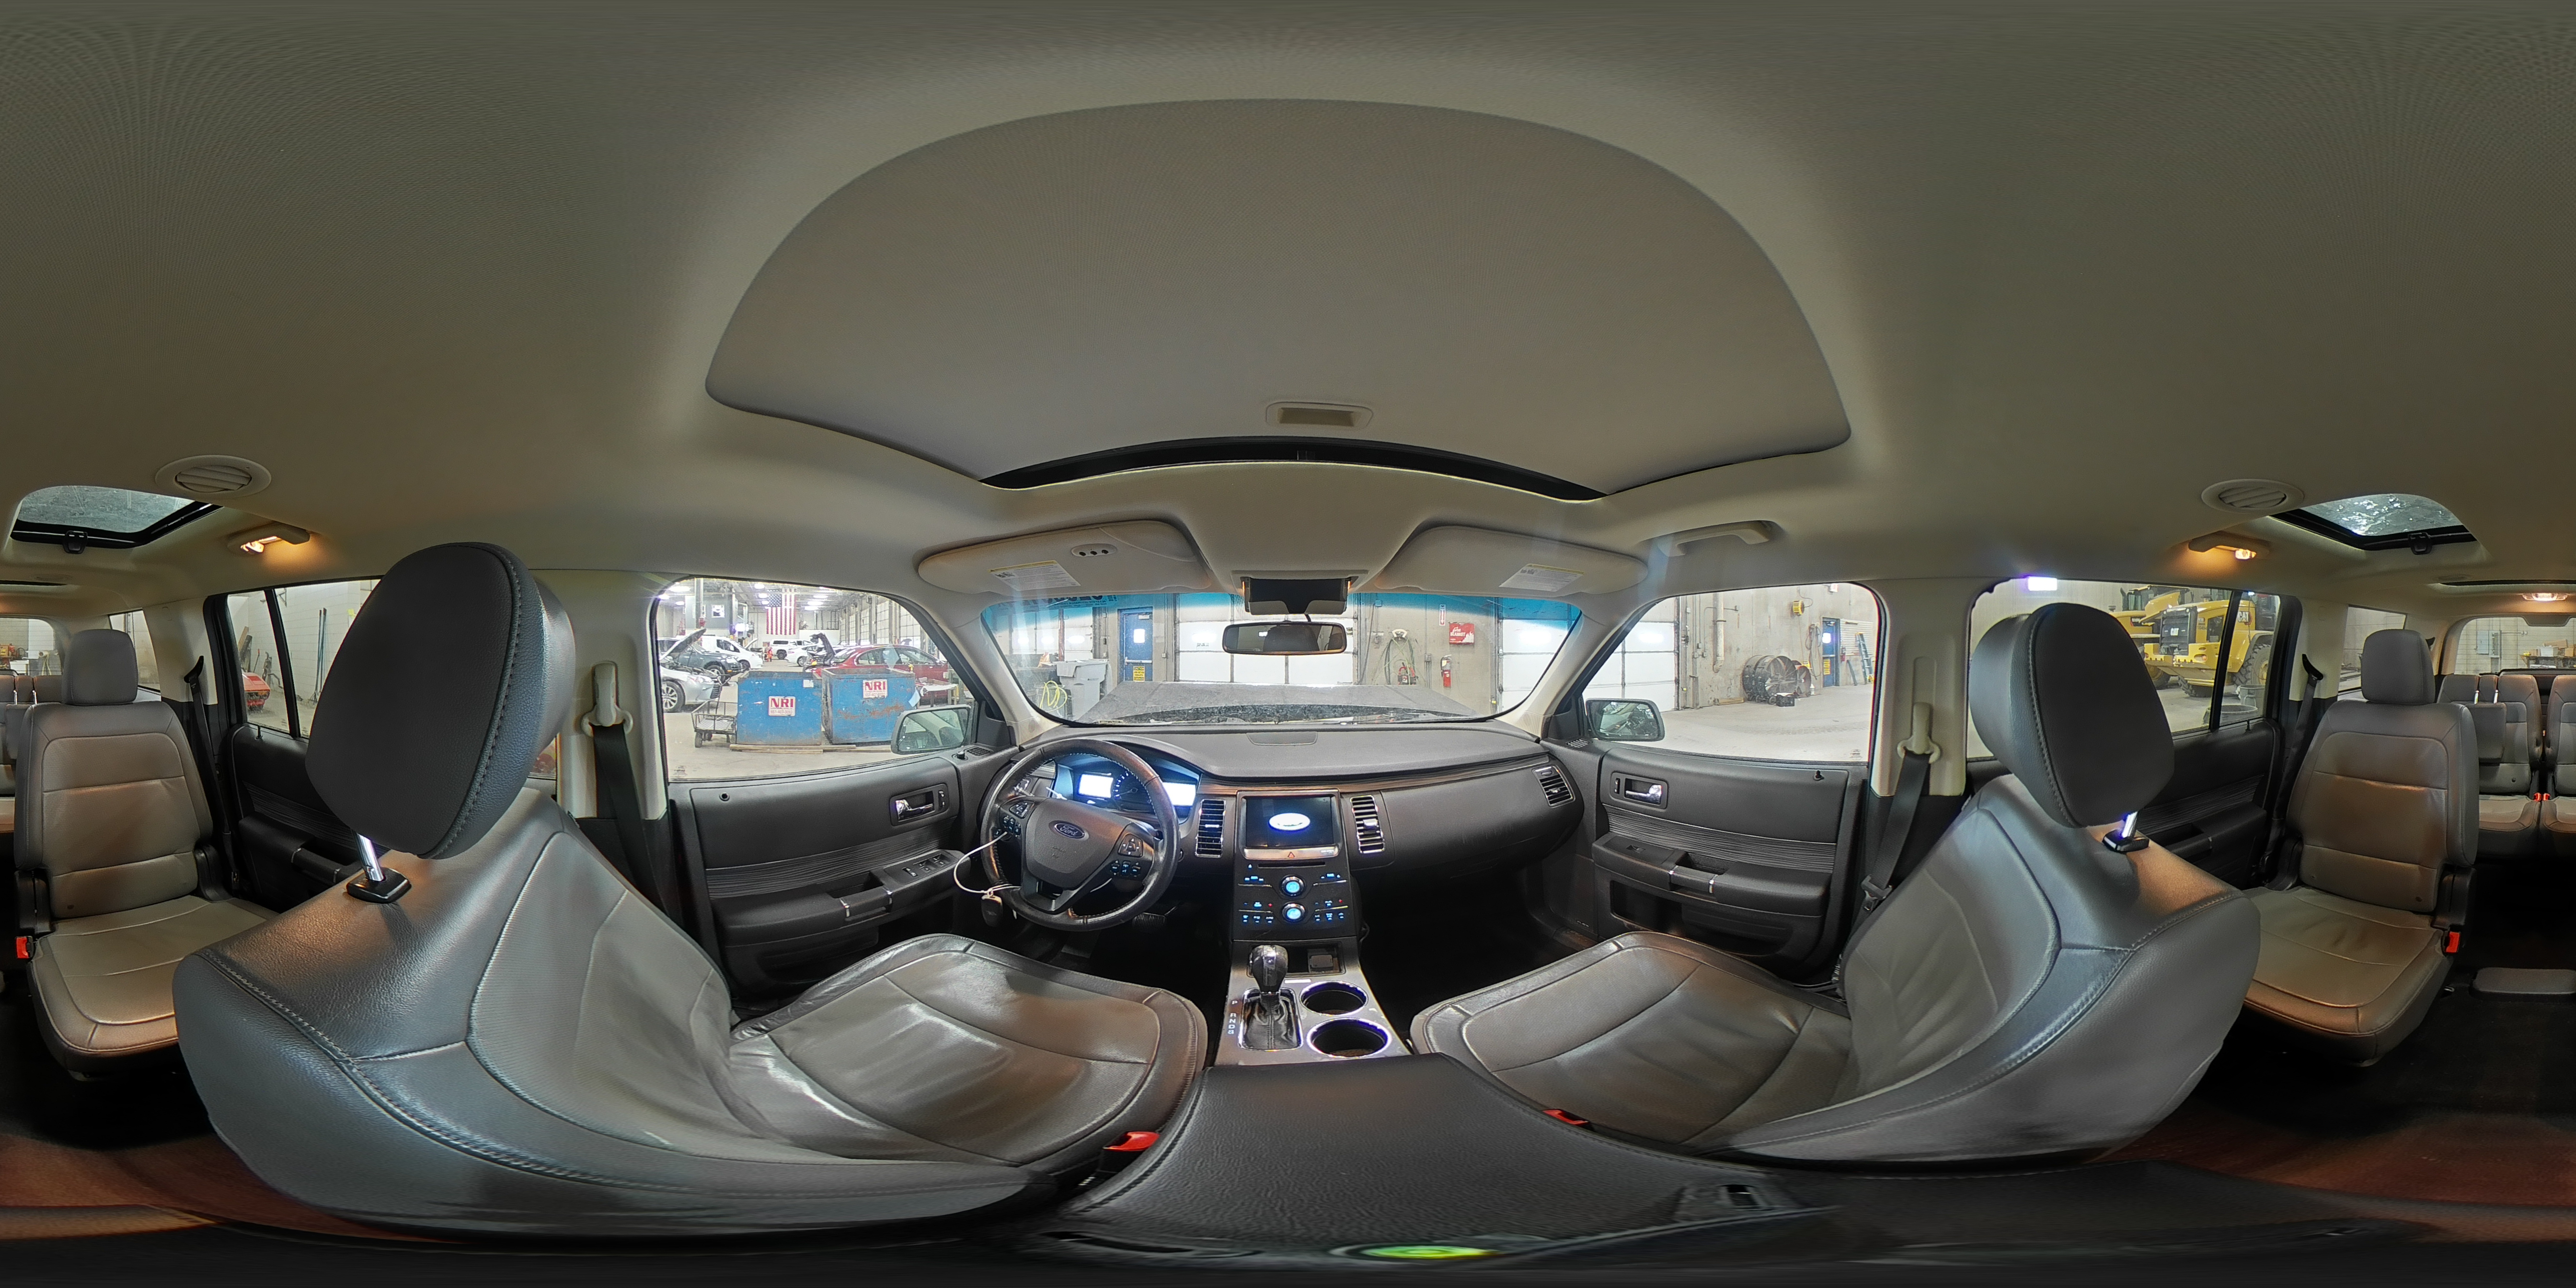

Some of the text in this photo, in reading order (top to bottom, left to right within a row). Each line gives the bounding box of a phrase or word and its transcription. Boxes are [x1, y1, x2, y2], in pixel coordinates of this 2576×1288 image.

[2238, 611, 2249, 622] CAT
[865, 681, 886, 690] NRI
[770, 698, 794, 708] NRI
[1060, 825, 1079, 836] Ford
